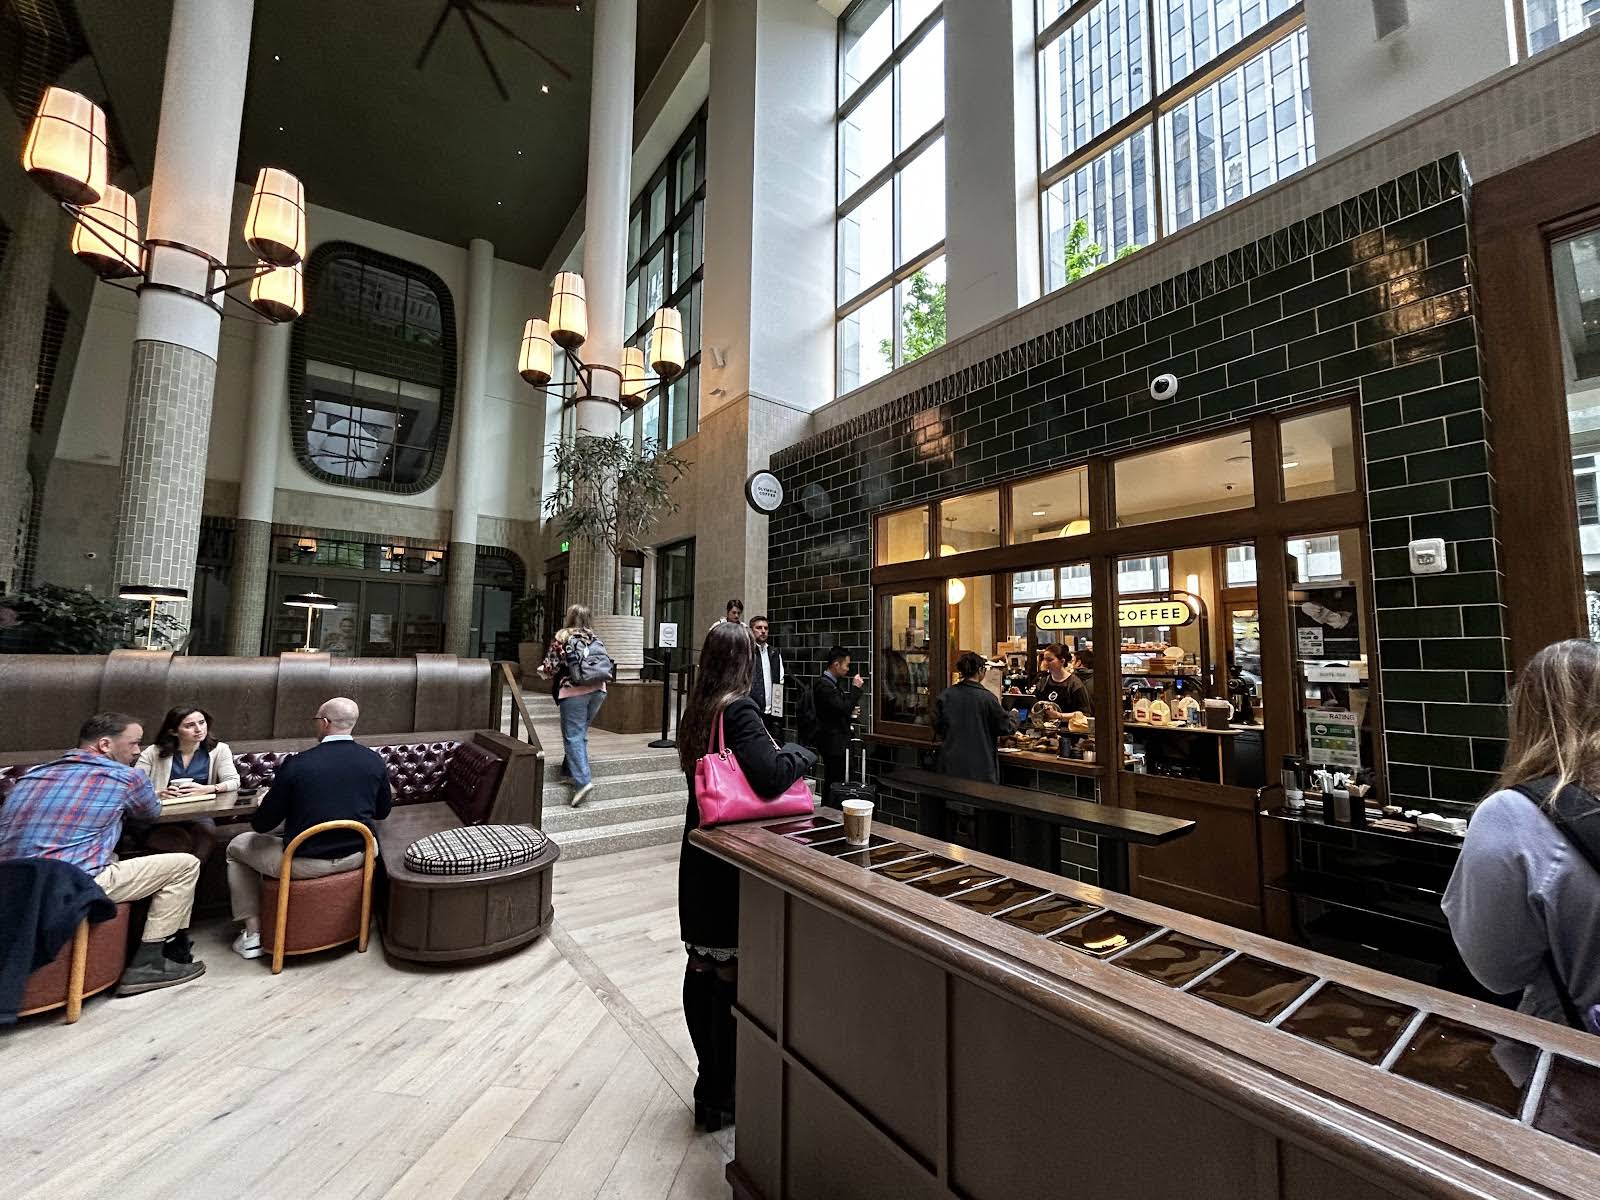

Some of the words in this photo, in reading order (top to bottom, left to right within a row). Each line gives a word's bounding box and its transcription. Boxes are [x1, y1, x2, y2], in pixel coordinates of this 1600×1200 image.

[1042, 612, 1093, 624] OLYMP
[1118, 607, 1181, 621] COFFEE
[1328, 713, 1355, 721] RATING
